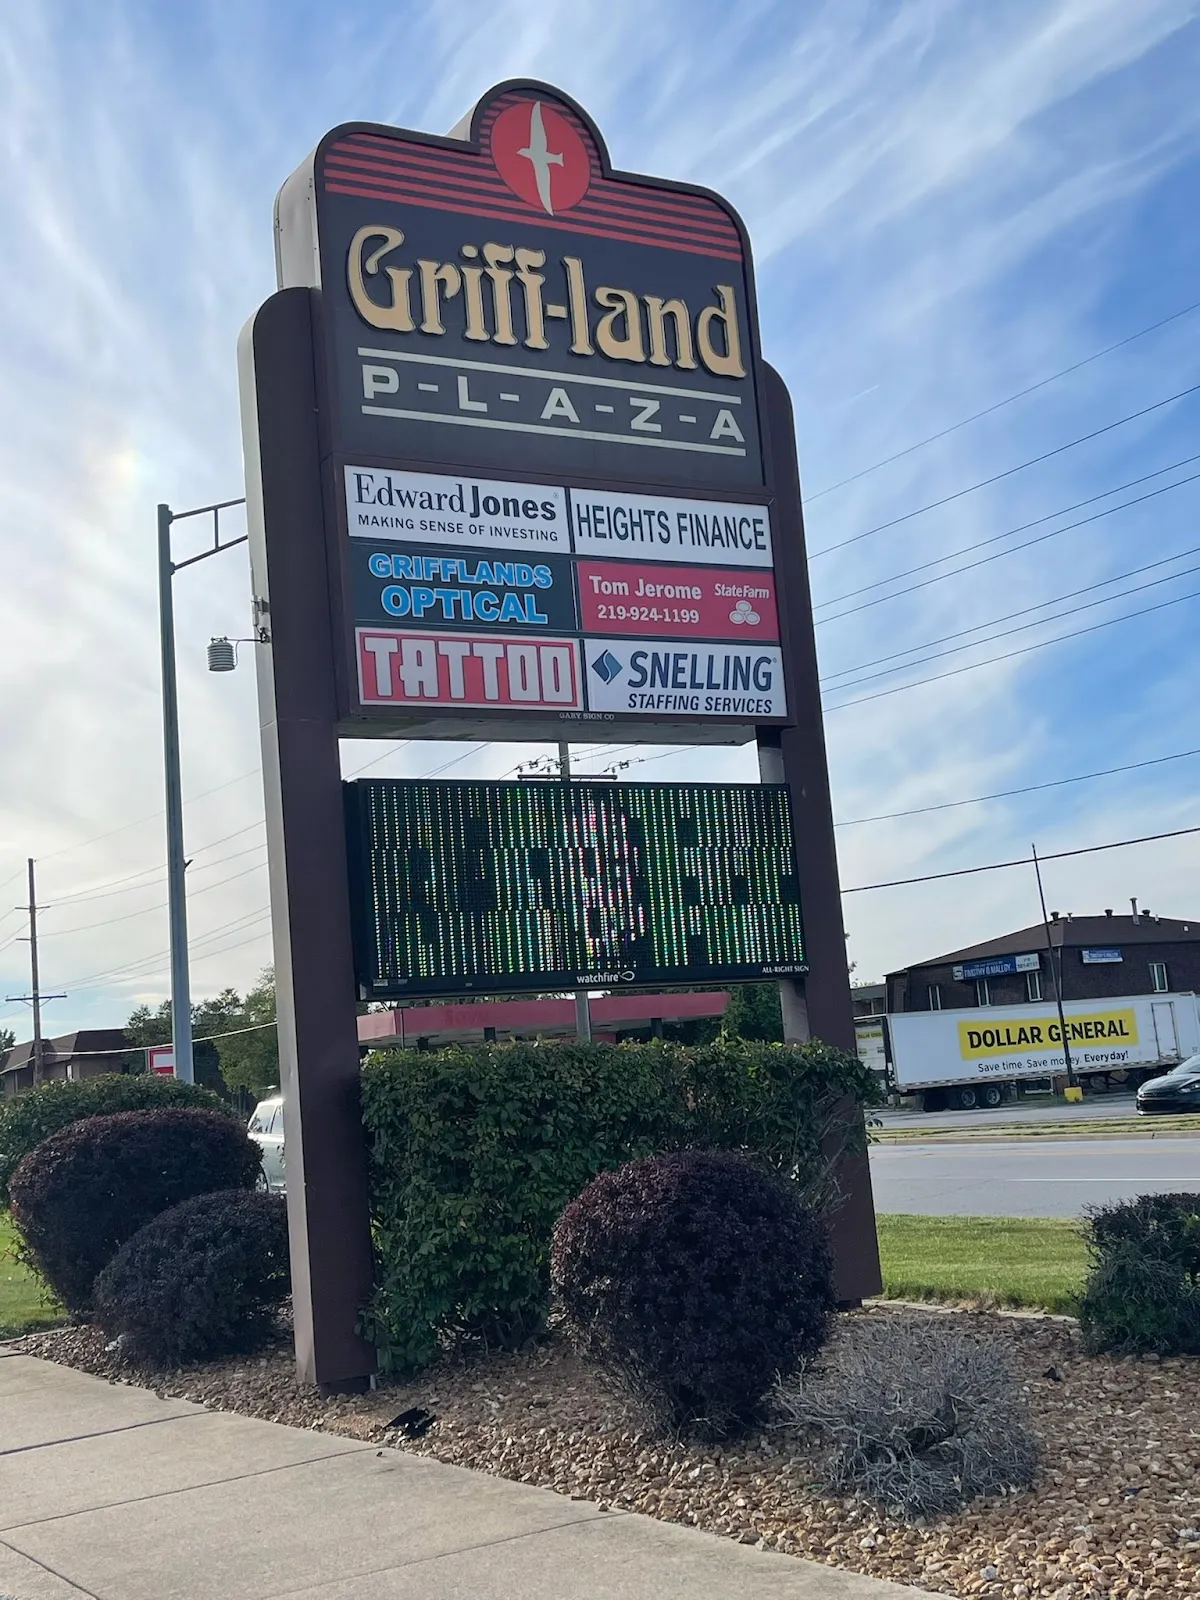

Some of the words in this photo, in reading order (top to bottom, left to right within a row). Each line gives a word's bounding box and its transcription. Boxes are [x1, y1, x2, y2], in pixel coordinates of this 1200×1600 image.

[347, 225, 747, 379] Griff-land
[358, 514, 415, 530] MAKING
[420, 520, 464, 534] SENSE
[468, 524, 485, 535] OF
[490, 526, 558, 542] INVESTING
[577, 504, 671, 544] HEIGHTS
[677, 513, 767, 550] FINANCE
[369, 553, 553, 589] GRIFFLANDS
[589, 575, 629, 596] Tom
[635, 579, 702, 600] Jerome
[381, 585, 549, 625] OPTICAL
[597, 604, 700, 624] 219-924-1199
[364, 636, 574, 703] TATTOO
[627, 650, 773, 692] SNELLING
[628, 694, 700, 711] STAFFING
[704, 696, 773, 714] SERVICES
[577, 972, 619, 983] watchfire
[794, 964, 810, 972] SIGN
[967, 1026, 1043, 1049] DOLLAR
[1048, 1019, 1130, 1042] GENERAL
[978, 1062, 1000, 1073] Save
[1002, 1059, 1025, 1070] time.
[1026, 1057, 1048, 1068] Save
[1084, 1050, 1129, 1064] Everyday!
